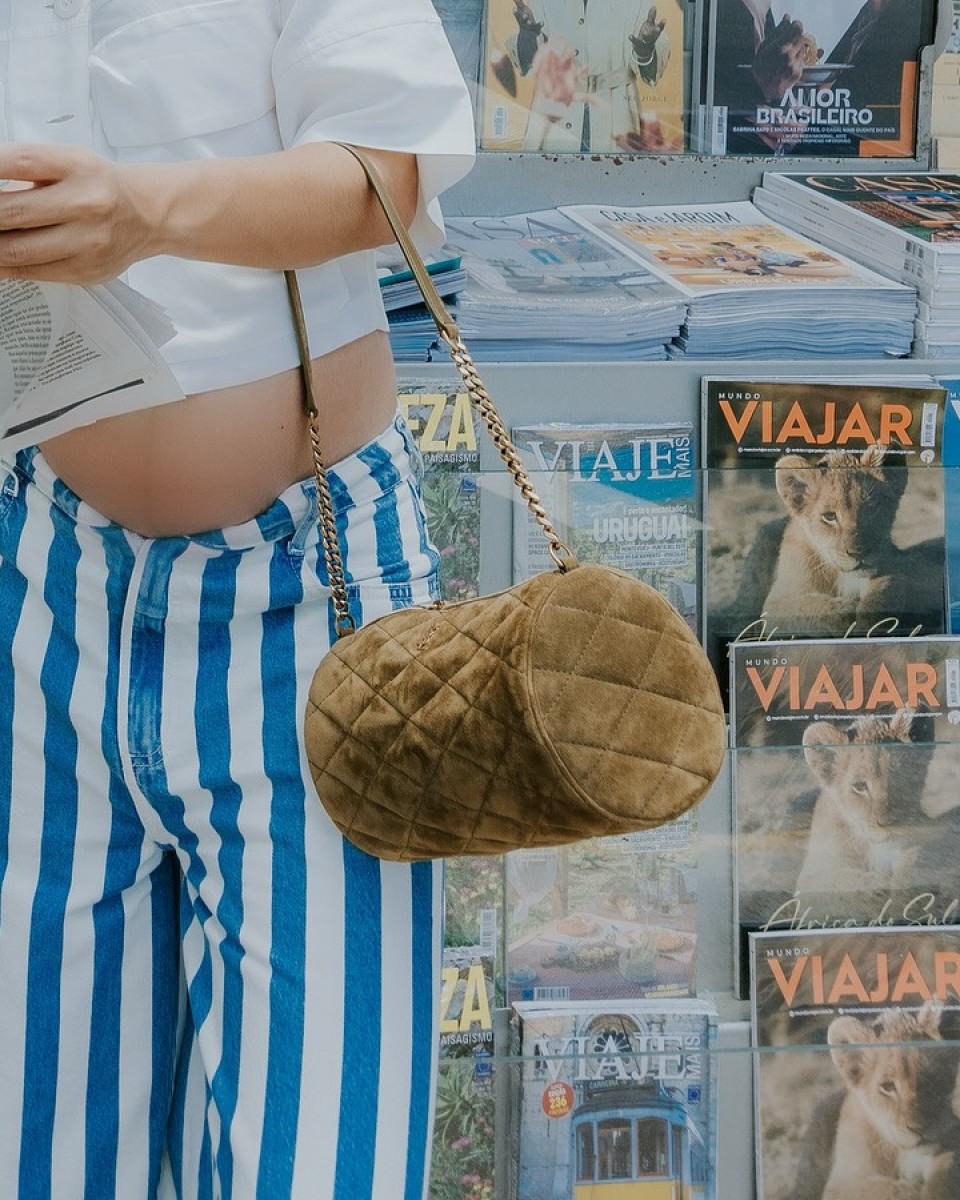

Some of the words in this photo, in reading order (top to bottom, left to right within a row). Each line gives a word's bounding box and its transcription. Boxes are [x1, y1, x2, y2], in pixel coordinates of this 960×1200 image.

[756, 108, 873, 125] BRASILEIRO
[600, 210, 655, 223] CASA
[663, 211, 740, 224] JARDIM
[718, 392, 761, 400] MUNDO
[718, 400, 914, 446] VIAJAR
[425, 453, 477, 464] PAISAGISMO
[527, 438, 676, 483] VIAJE
[675, 436, 692, 478] MAIS
[593, 514, 688, 543] URUGUAI
[746, 658, 789, 666] MUNDO
[746, 661, 940, 713] VIAJAR
[767, 948, 810, 957] MUNDO
[768, 951, 960, 1006] VIAJAR
[536, 1033, 686, 1080] VIAJE
[685, 1034, 701, 1079] MAIS
